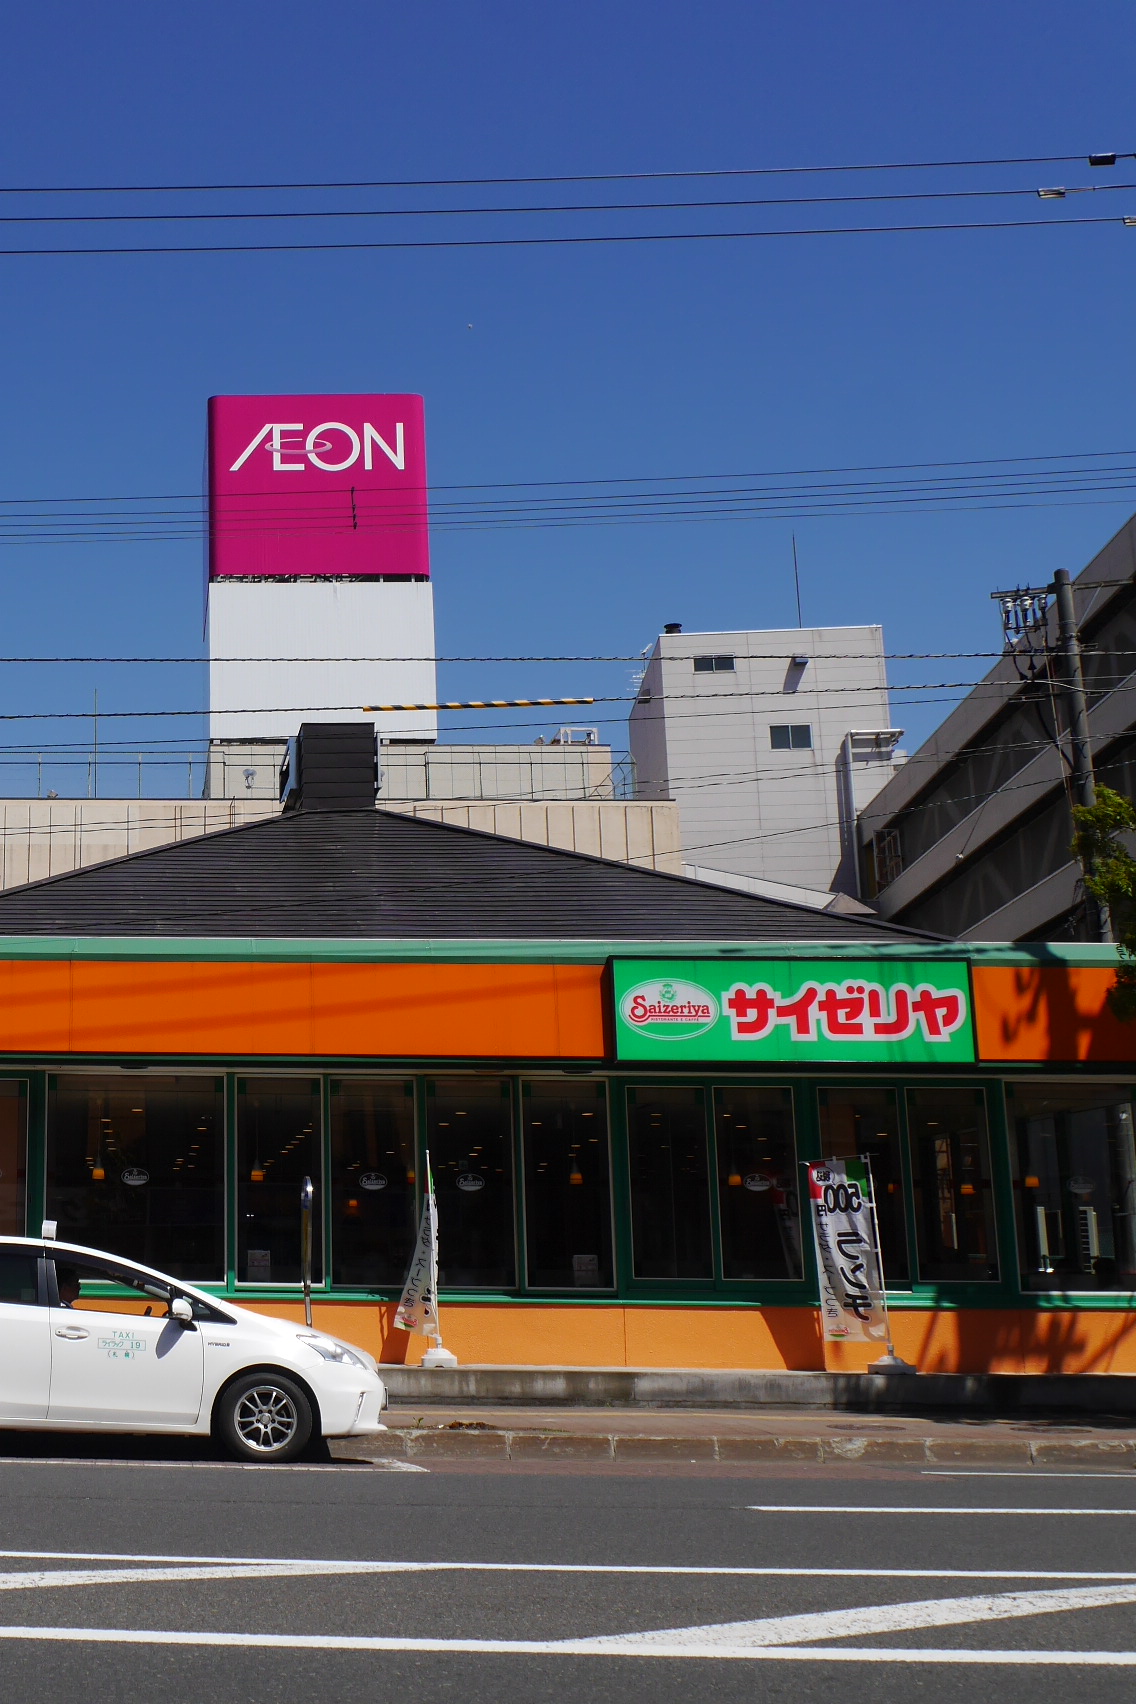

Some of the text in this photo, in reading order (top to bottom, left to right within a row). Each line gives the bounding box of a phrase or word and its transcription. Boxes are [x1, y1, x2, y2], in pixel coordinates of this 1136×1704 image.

[630, 994, 711, 1020] Saizeriya
[727, 985, 960, 1037] サイゼリヤ
[112, 1330, 135, 1339] TAXI
